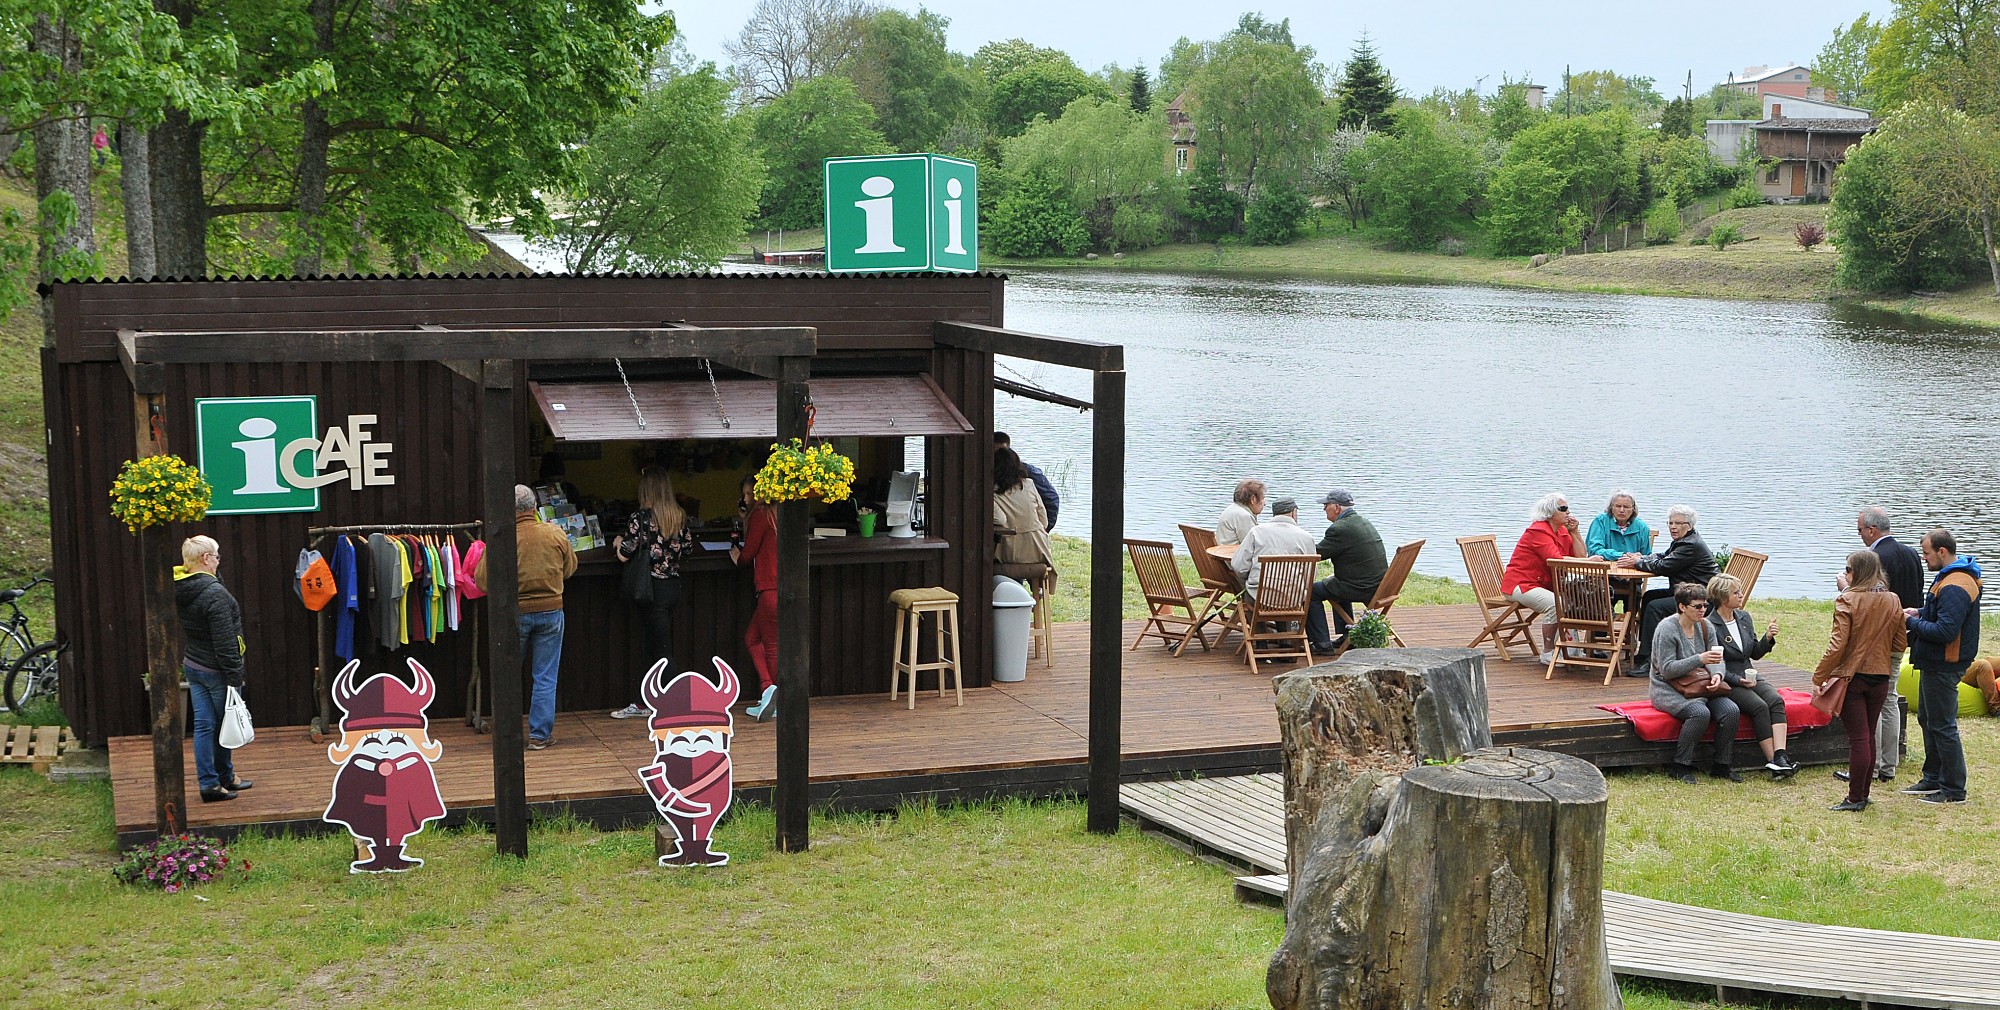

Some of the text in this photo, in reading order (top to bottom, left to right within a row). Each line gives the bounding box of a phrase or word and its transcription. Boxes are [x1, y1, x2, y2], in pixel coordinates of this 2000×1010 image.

[855, 176, 905, 254] i
[944, 178, 967, 255] i
[231, 414, 395, 495] i CAFE
